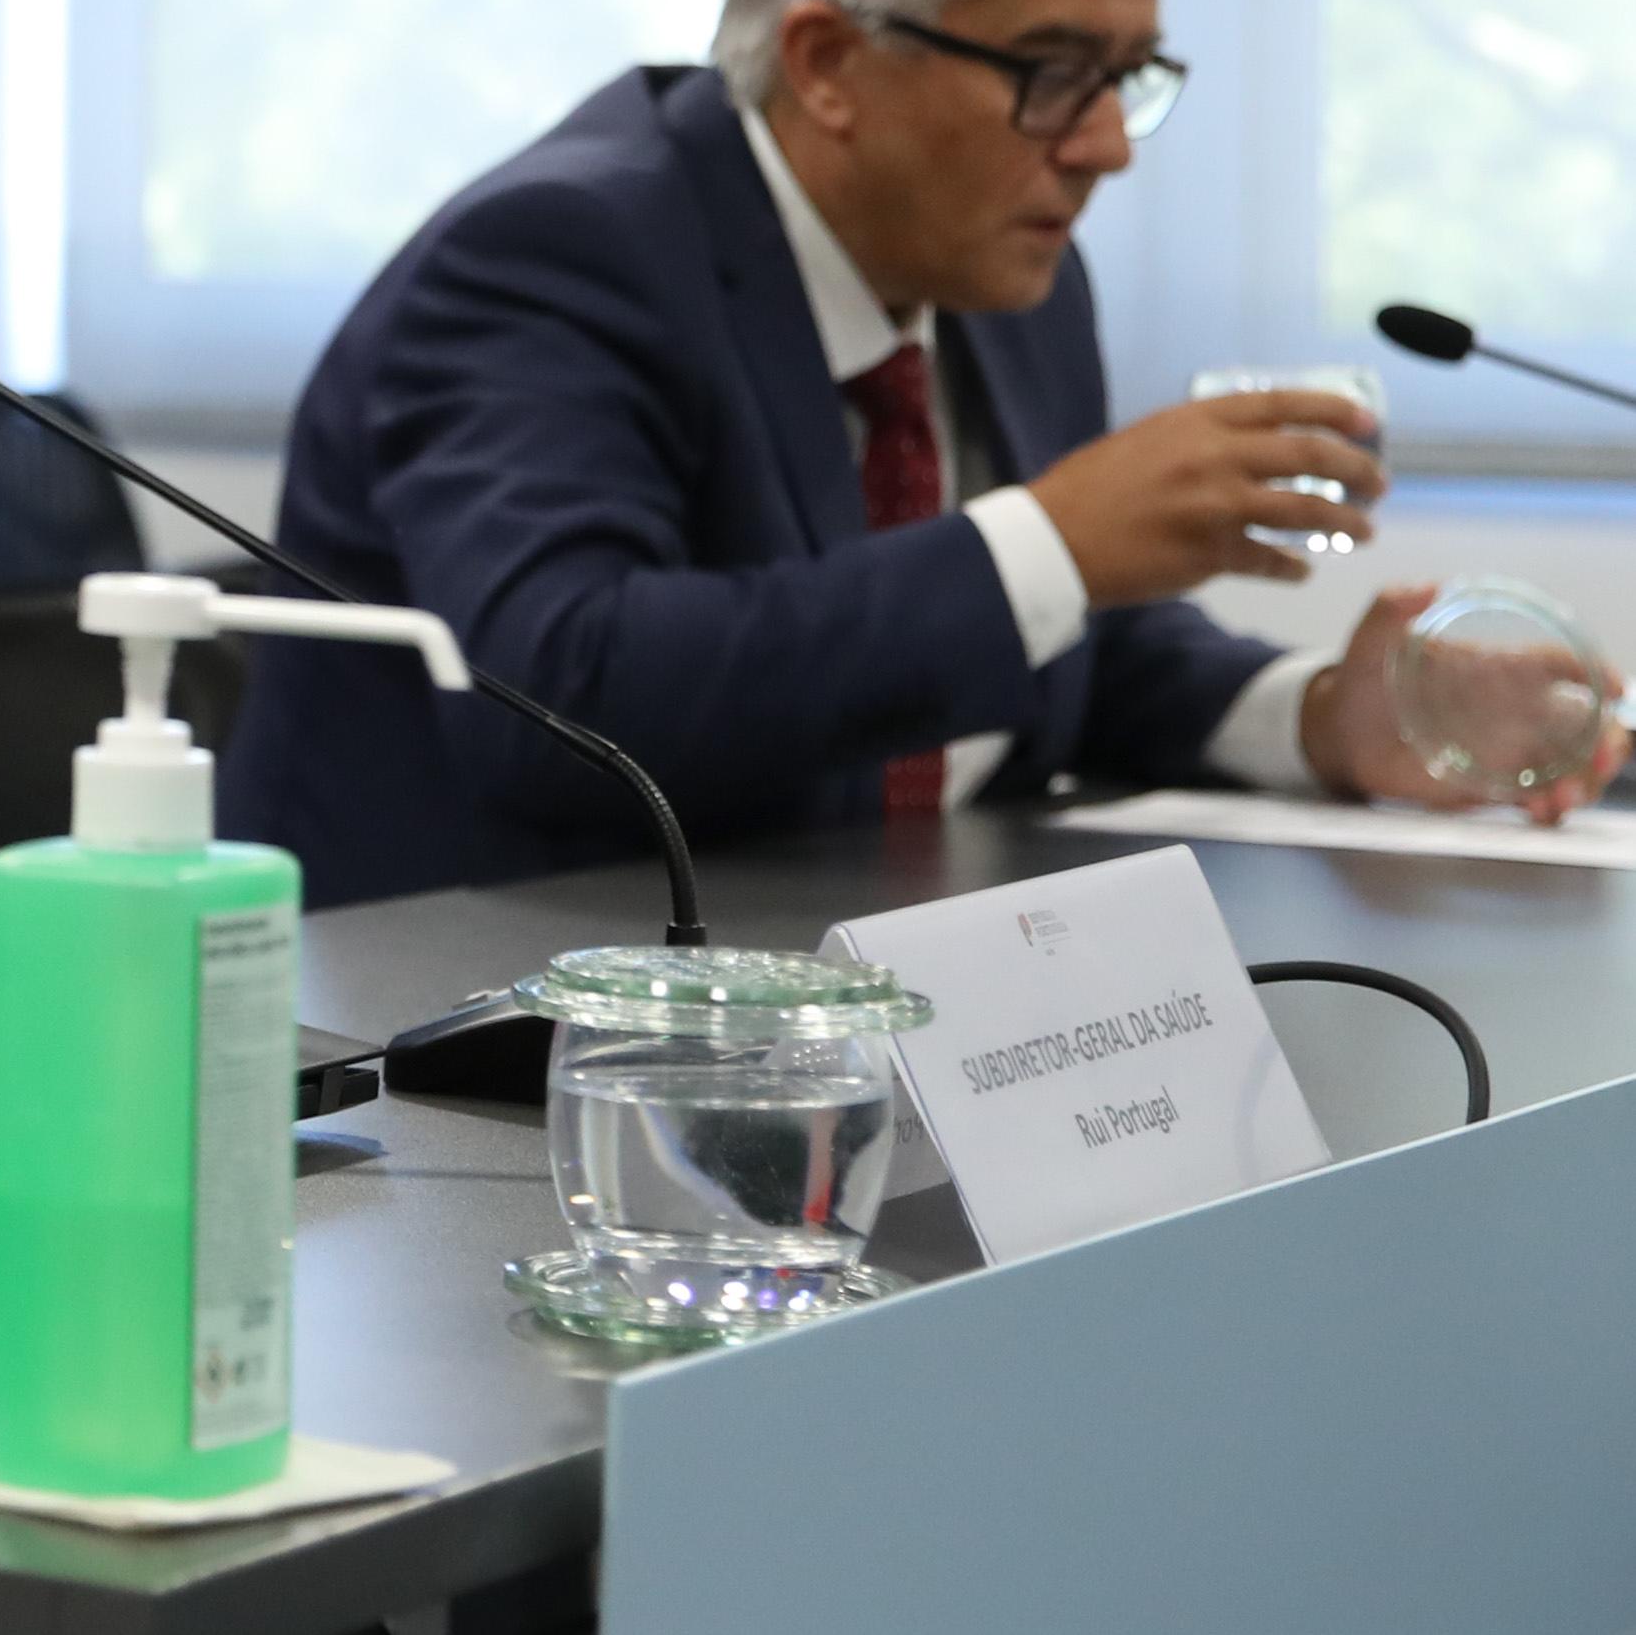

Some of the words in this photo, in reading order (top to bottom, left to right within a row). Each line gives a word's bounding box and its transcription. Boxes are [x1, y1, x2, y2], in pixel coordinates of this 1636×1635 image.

[961, 1016, 1135, 1095] SUBDIRETOR-GERAL
[1128, 1009, 1161, 1046] DA
[1153, 989, 1214, 1039] SAÚDE
[1075, 1107, 1112, 1149] Rui
[1104, 1084, 1180, 1134] Portugal
